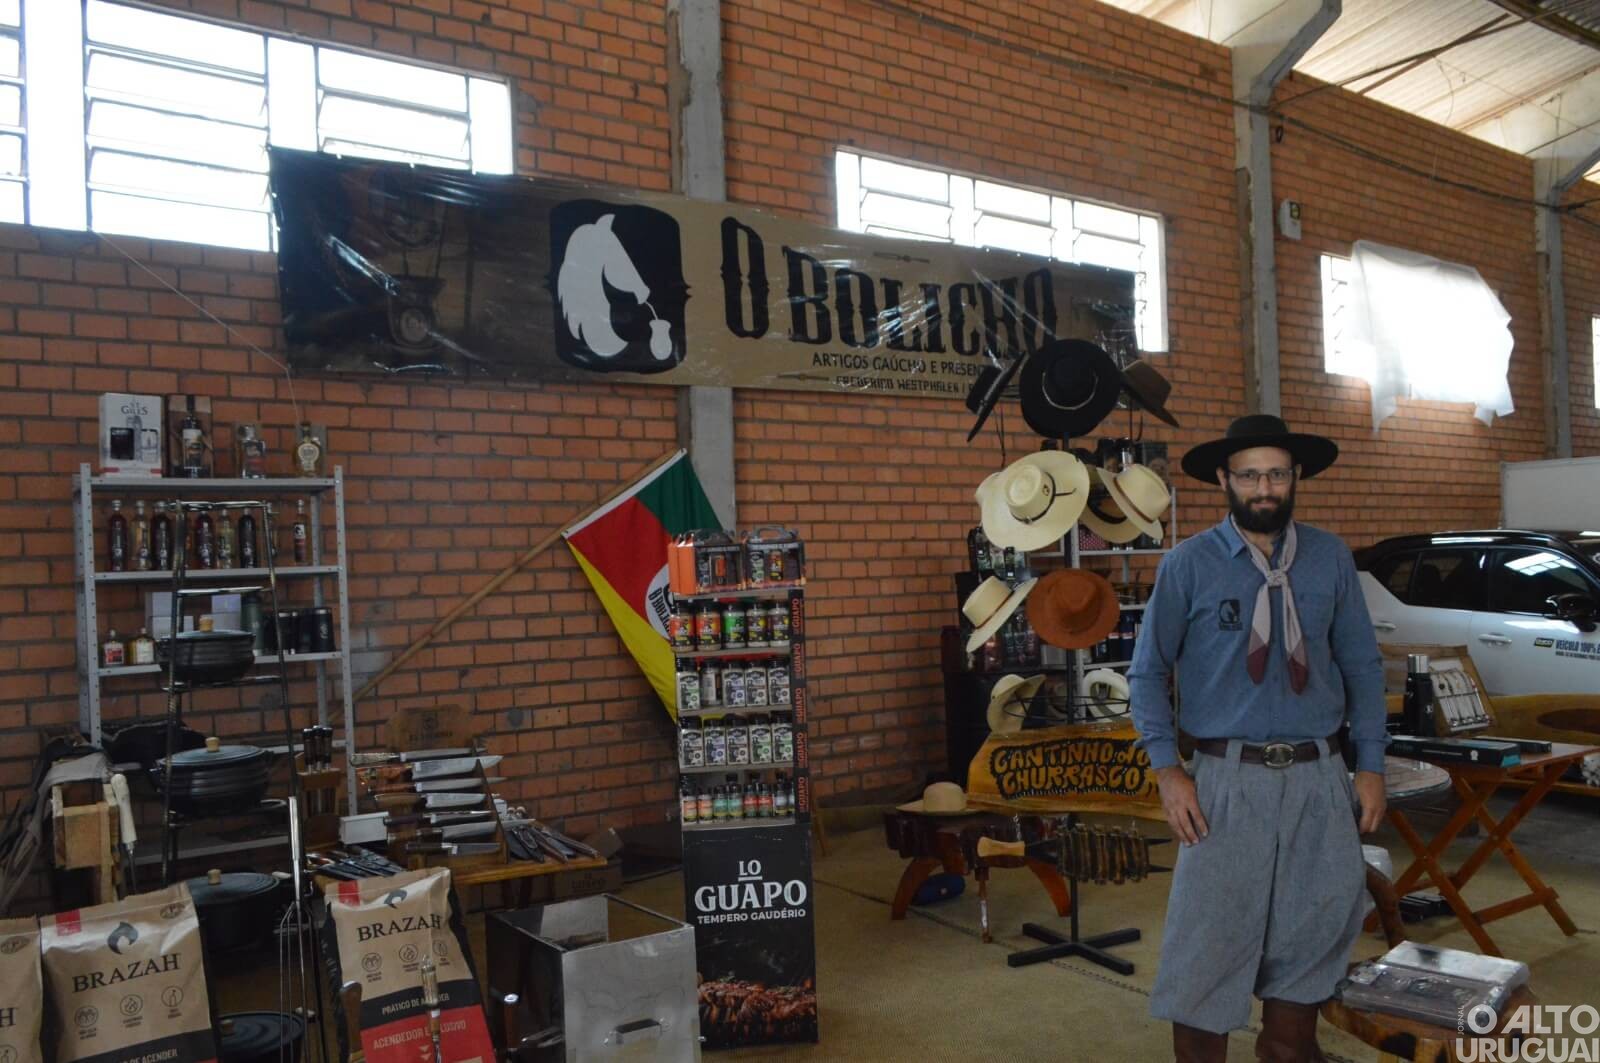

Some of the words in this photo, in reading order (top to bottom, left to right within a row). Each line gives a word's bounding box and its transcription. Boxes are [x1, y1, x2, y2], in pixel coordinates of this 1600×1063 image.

[720, 216, 770, 340] O
[781, 244, 1058, 358] BOLICHO
[812, 351, 869, 370] ARTIGOS
[872, 353, 927, 374] GAÚCHO
[930, 360, 938, 374] E
[835, 375, 894, 390] FREDERICO
[897, 379, 960, 393] WESTPHALEN
[1002, 765, 1141, 795] CHURRASCO
[738, 859, 762, 877] LO
[694, 879, 807, 912] GUAPO
[357, 913, 442, 943] BRAZAH
[697, 912, 748, 925] TEMPERO
[750, 907, 806, 921] GAUDÉRIO
[71, 952, 182, 993] BRAZAH
[373, 1027, 424, 1050] ACENDEDOR
